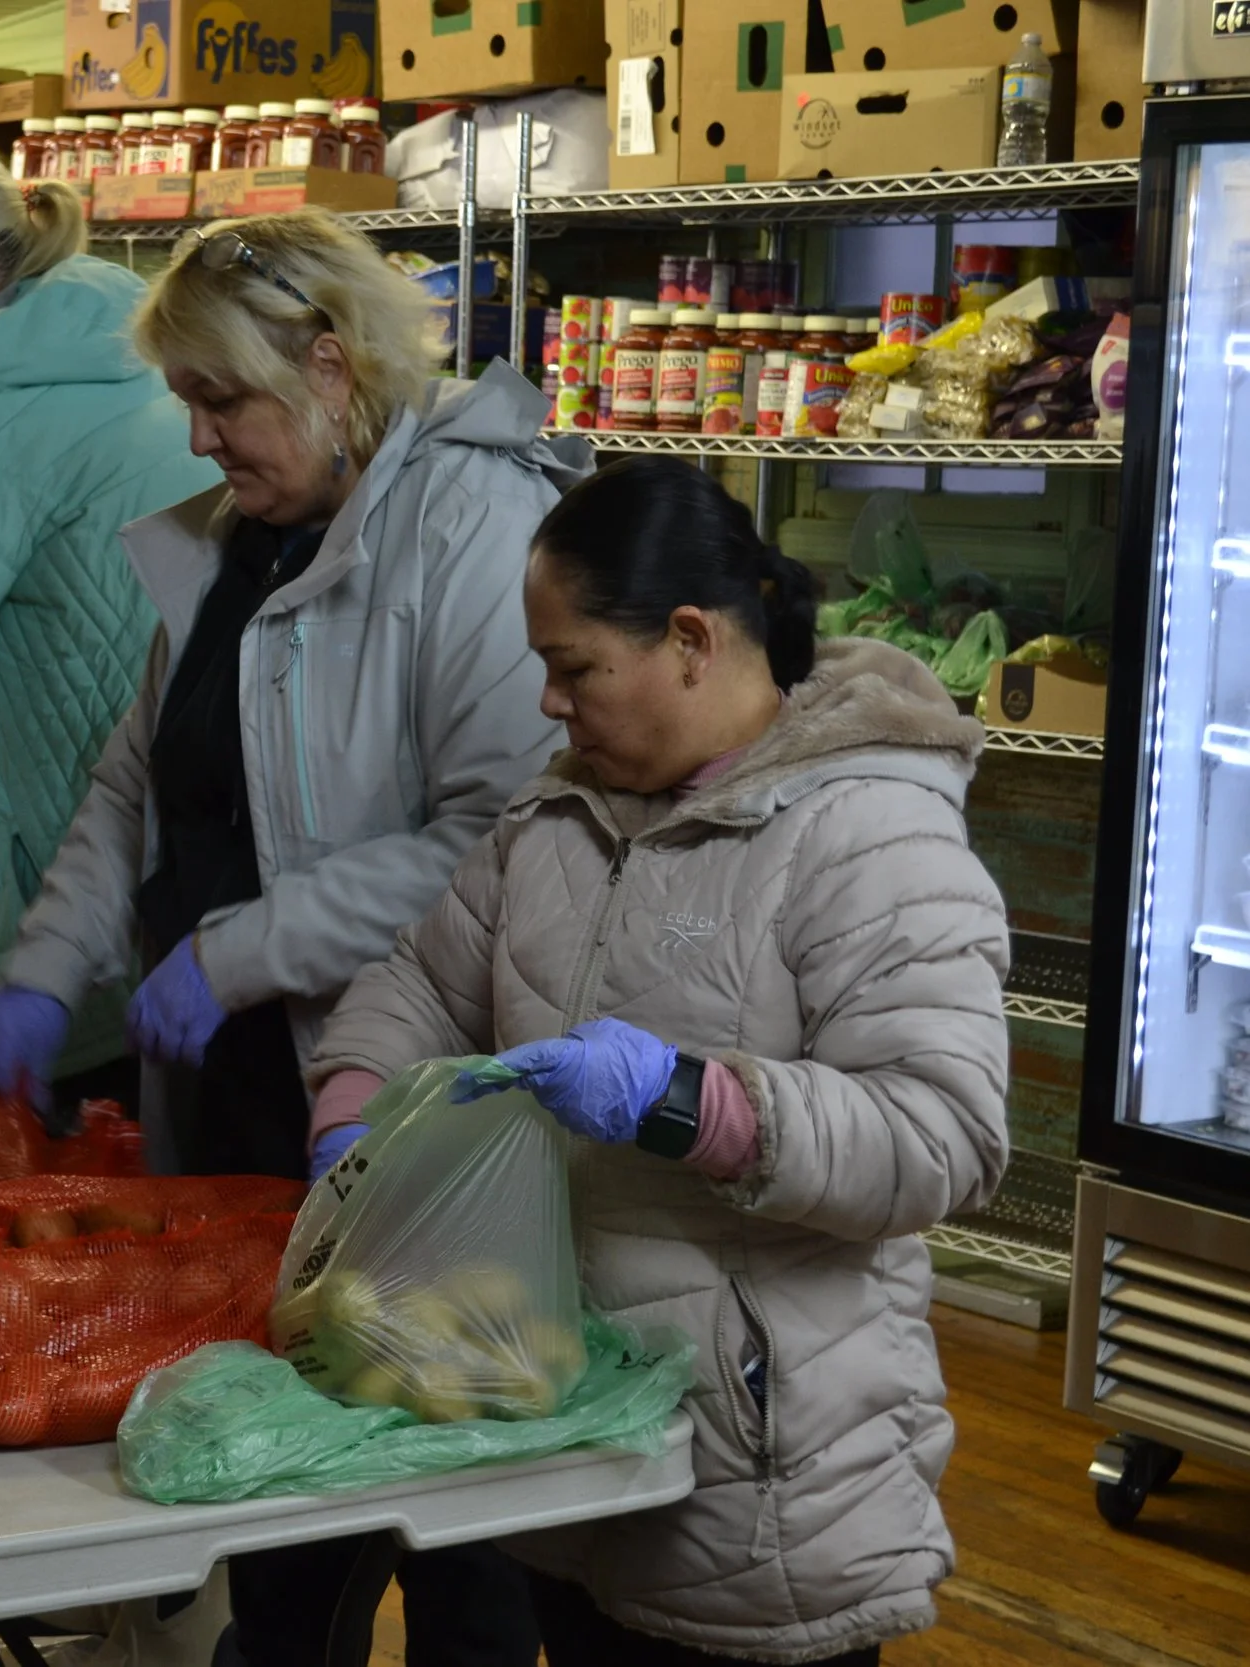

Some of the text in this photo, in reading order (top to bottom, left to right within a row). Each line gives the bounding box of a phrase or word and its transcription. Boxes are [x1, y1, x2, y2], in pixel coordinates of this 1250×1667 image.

[196, 18, 298, 84] fyffes
[891, 298, 934, 313] Unico
[617, 354, 654, 370] Prego
[661, 354, 698, 370] Prego
[658, 911, 717, 931] eebok
